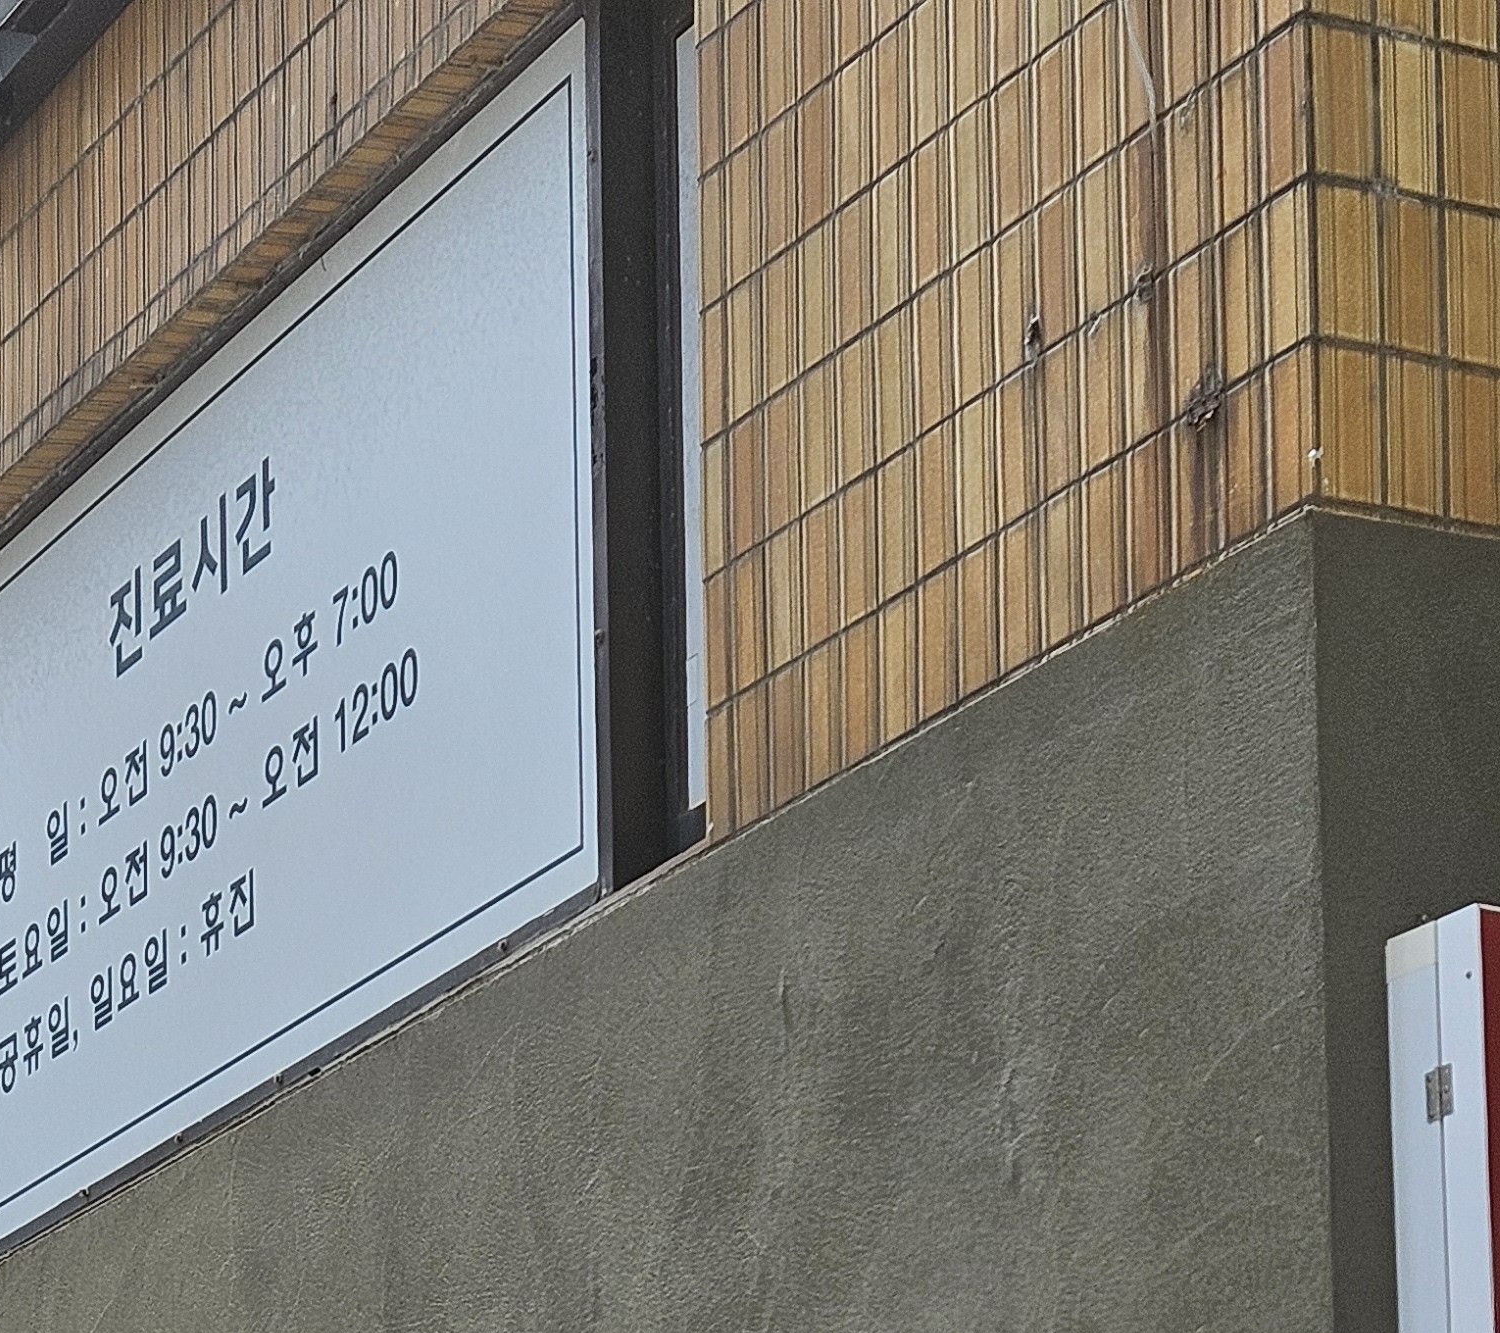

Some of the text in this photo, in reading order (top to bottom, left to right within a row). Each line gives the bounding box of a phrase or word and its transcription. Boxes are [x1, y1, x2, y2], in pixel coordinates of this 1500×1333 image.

[98, 738, 149, 828] 오전
[158, 690, 217, 778] 9:30
[261, 608, 319, 704] 오후
[332, 550, 400, 648] 7:00
[108, 456, 277, 678] 진료시간
[98, 838, 149, 927] 오전
[158, 793, 217, 879] 9:30
[261, 715, 320, 810] 오전
[332, 648, 419, 754] 12:00
[200, 867, 256, 959] 휴진
